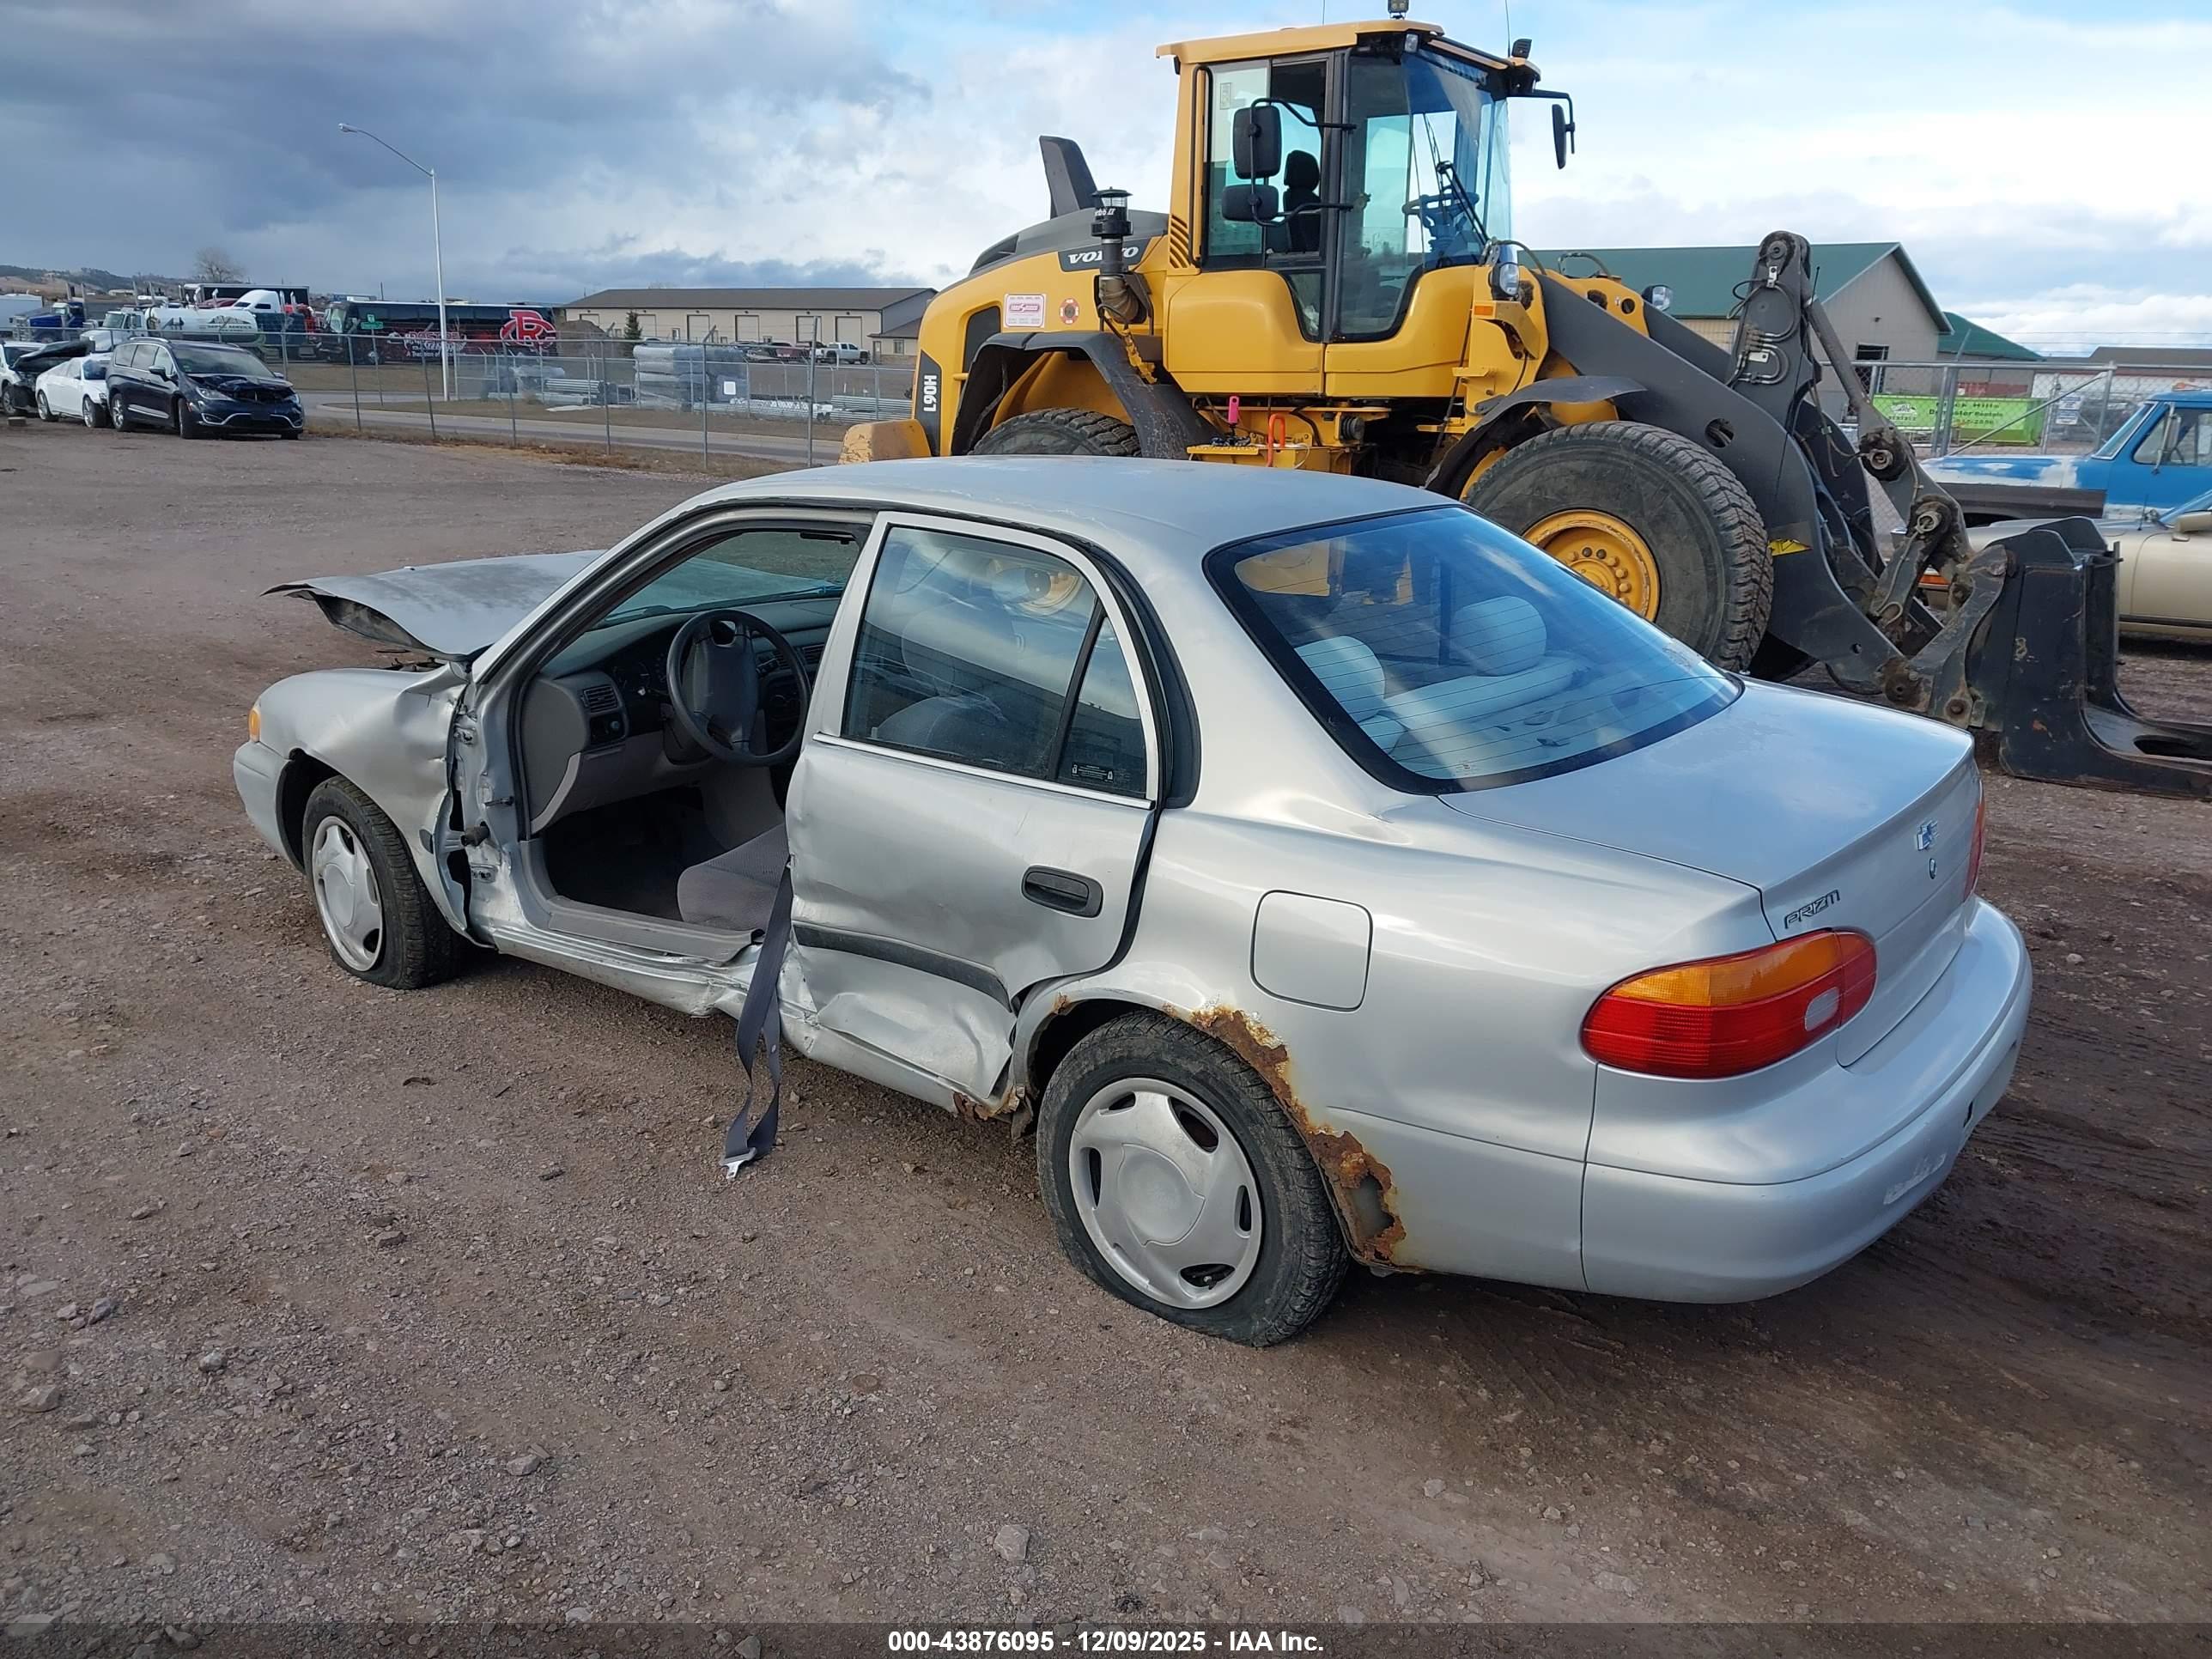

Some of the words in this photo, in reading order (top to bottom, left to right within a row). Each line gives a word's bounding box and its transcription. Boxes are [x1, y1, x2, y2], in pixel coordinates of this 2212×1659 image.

[1067, 246, 1139, 264] VOLO
[923, 374, 937, 412] L90H
[1784, 889, 1840, 929] PRIZM
